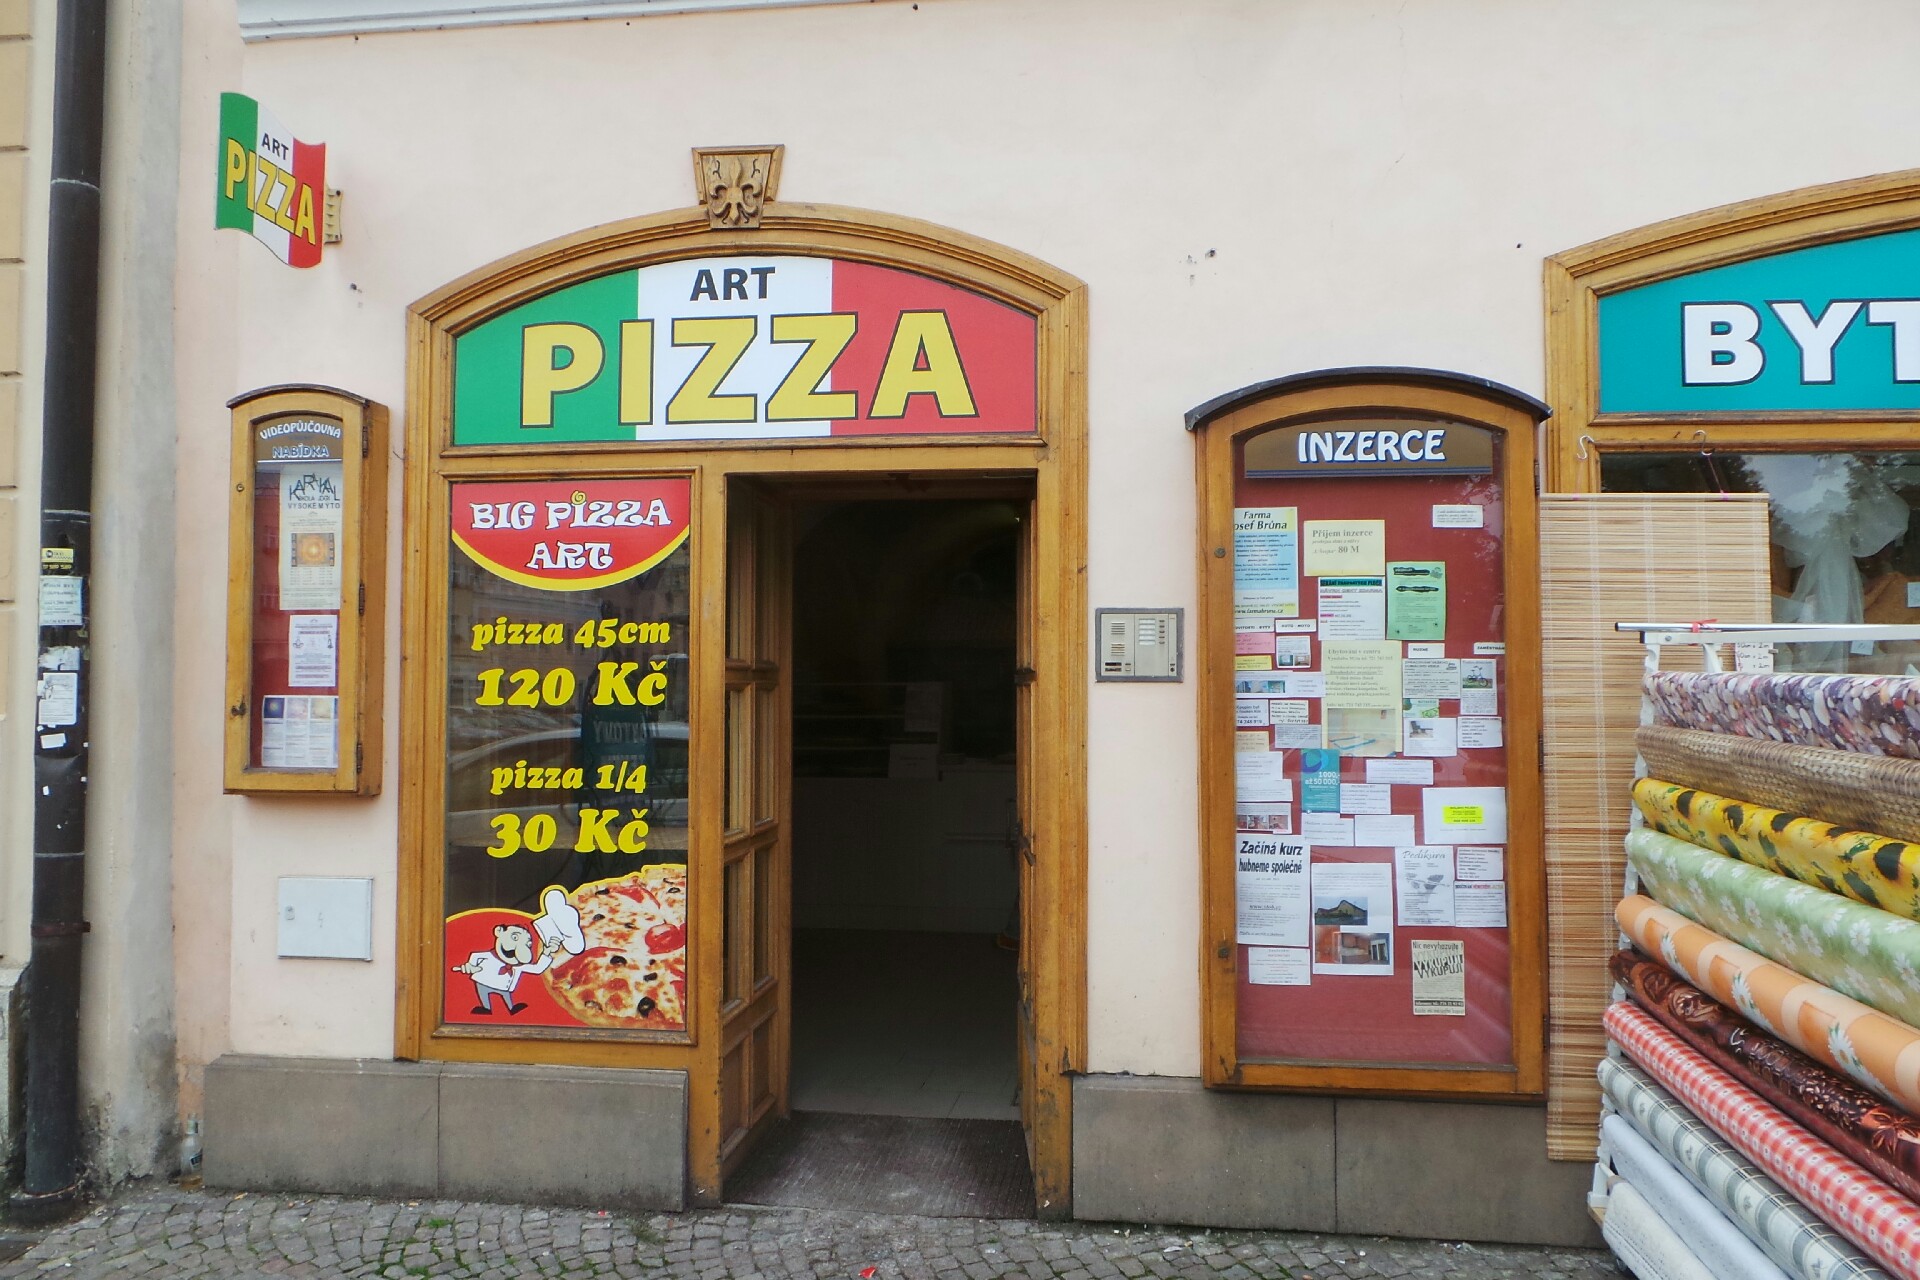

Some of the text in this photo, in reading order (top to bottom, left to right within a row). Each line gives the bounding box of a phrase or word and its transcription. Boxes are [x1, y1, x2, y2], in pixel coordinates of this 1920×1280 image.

[262, 133, 289, 160] ART
[225, 137, 316, 245] PIZZA
[689, 267, 775, 301] ART
[1681, 298, 1920, 387] BYT
[519, 309, 979, 429] PIZZA
[260, 420, 342, 440] VIDEOPŮJČOVNA
[272, 443, 329, 459] NABÍDKA
[1298, 429, 1446, 463] INZERCE
[470, 501, 536, 530] BIG
[1243, 511, 1271, 520] Farma
[1343, 529, 1374, 537] inzerce
[526, 541, 613, 570] ART
[471, 616, 670, 651] pizza 45cm
[475, 661, 667, 708] 120 Kč
[490, 759, 646, 795] pizza 1/4
[486, 808, 649, 858] 30 Kč
[1240, 840, 1303, 856] Začíná kurz
[1238, 858, 1270, 873] hubneme
[1413, 941, 1423, 949] Nic
